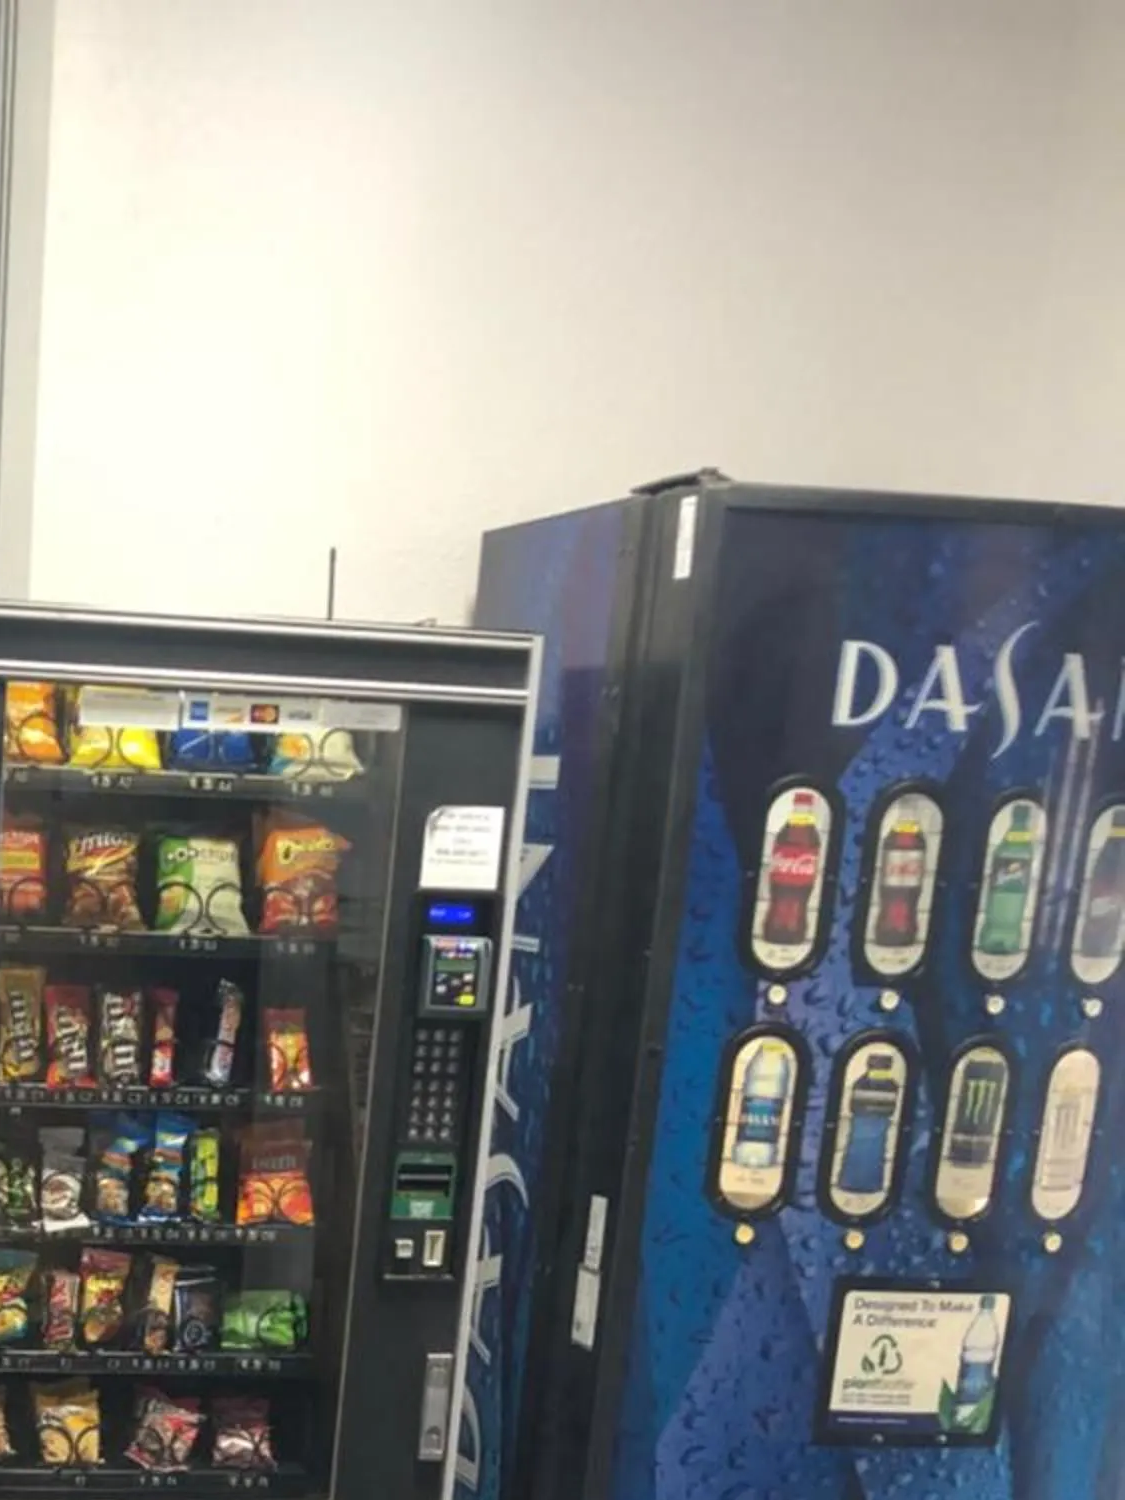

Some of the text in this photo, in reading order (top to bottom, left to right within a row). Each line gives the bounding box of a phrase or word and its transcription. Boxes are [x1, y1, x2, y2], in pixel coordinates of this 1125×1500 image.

[854, 1297, 973, 1312] Designed To Make
[853, 1314, 938, 1328] A Difference
